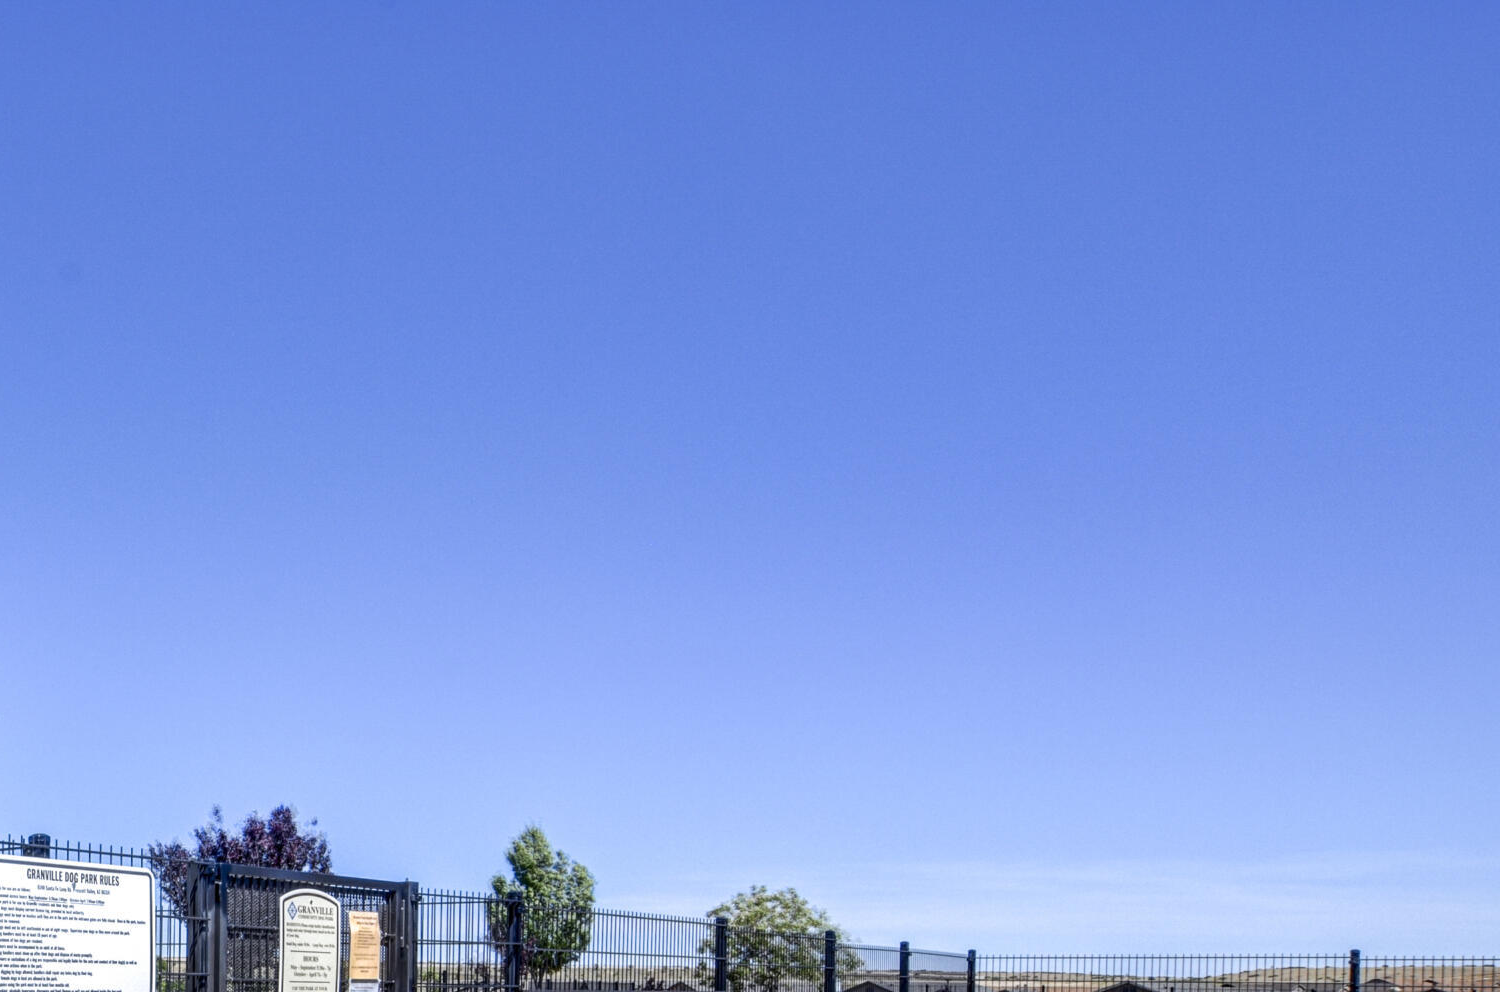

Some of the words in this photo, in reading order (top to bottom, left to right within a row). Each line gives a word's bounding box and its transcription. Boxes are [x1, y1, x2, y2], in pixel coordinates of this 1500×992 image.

[27, 868, 63, 881] GRANVILLE
[65, 872, 78, 883] DOG
[81, 875, 98, 885] PARK
[100, 876, 120, 887] RULES
[297, 904, 333, 916] GRANVILLE
